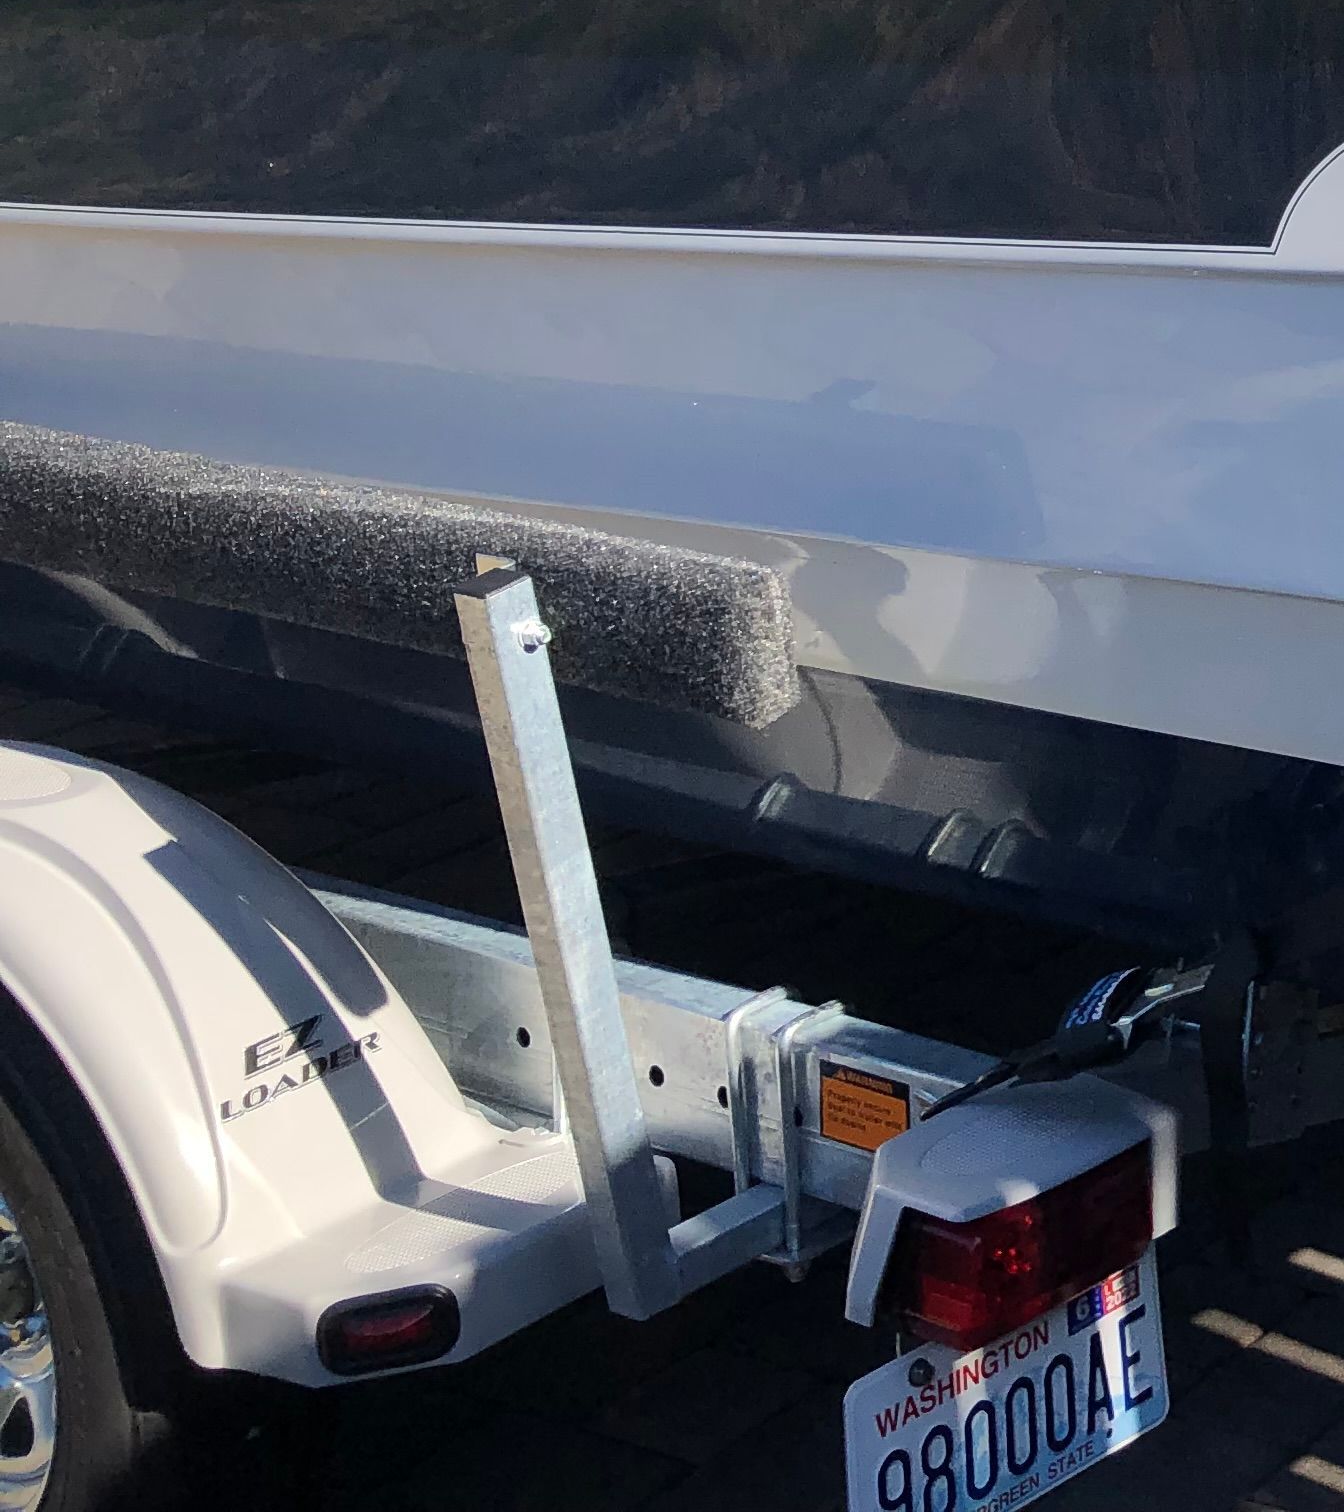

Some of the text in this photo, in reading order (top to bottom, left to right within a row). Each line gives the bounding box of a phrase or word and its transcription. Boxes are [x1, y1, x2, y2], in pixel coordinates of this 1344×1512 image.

[220, 1031, 383, 1123] LOADER
[244, 1014, 323, 1079] EZ
[875, 1320, 1050, 1437] WASHINGTON
[1047, 1439, 1094, 1480] STATE
